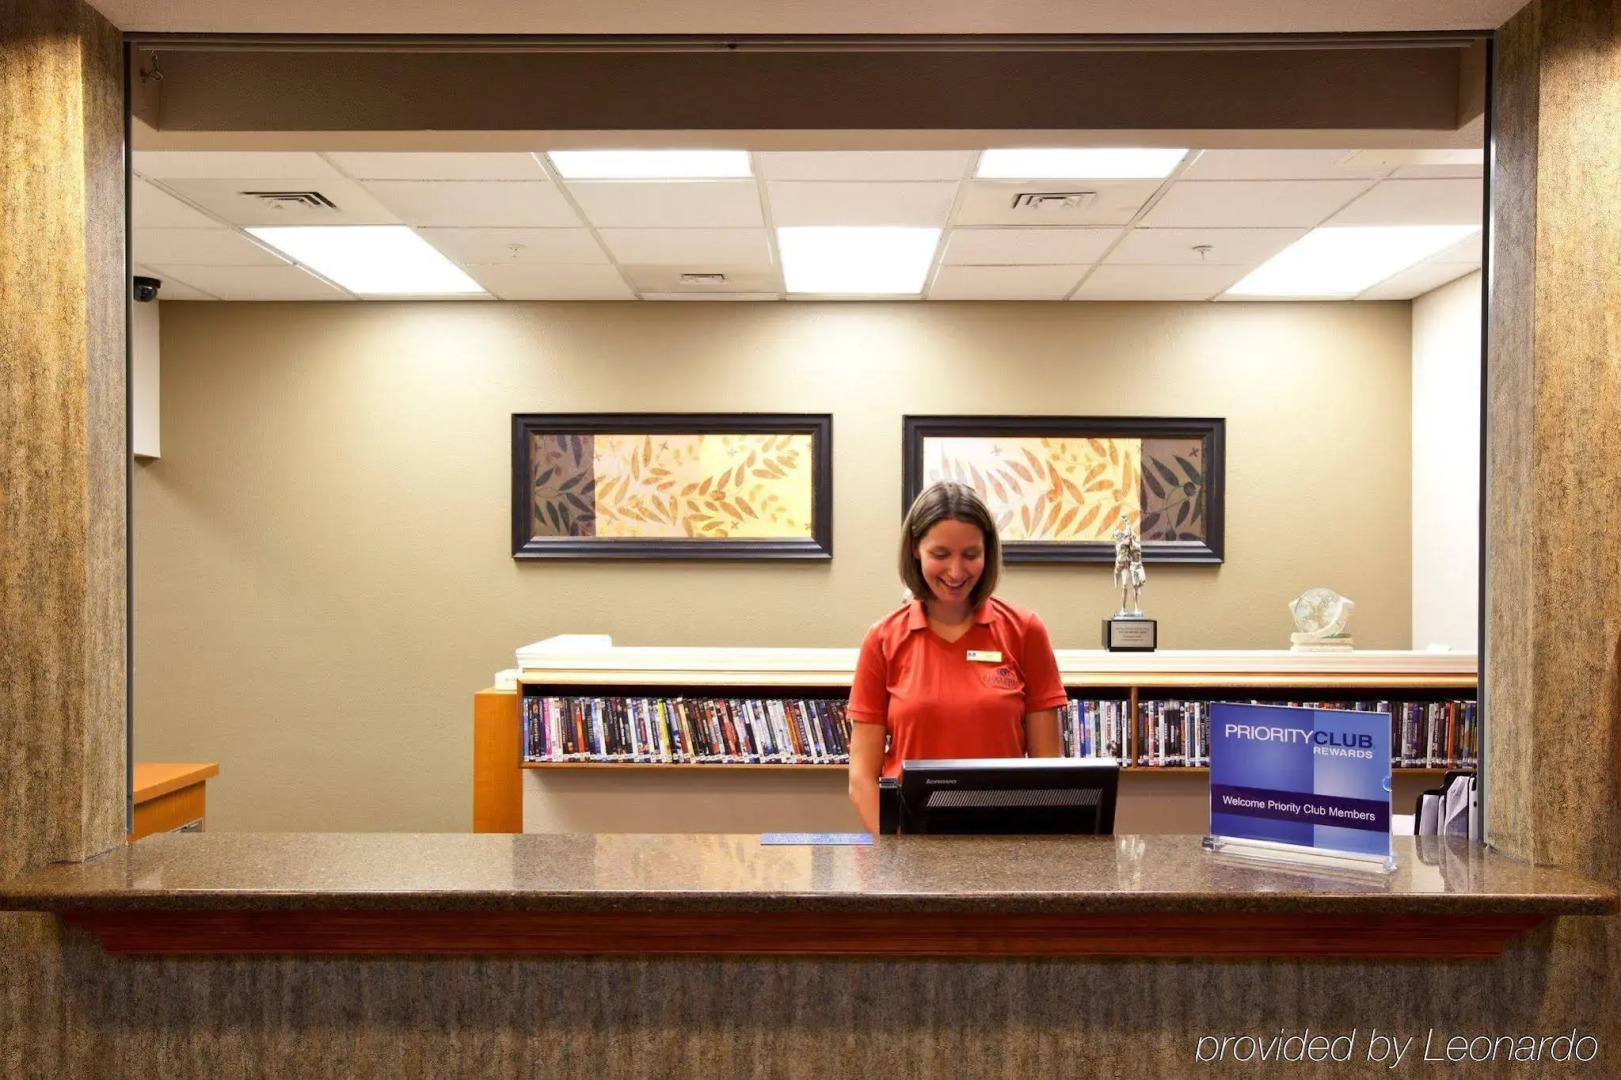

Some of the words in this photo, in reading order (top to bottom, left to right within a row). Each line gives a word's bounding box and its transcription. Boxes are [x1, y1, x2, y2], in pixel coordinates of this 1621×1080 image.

[1313, 747, 1373, 759] REWARDS
[1222, 795, 1265, 809] Welcome
[1267, 800, 1301, 815] Priority
[1303, 804, 1326, 816] Club
[1328, 806, 1376, 821] Members
